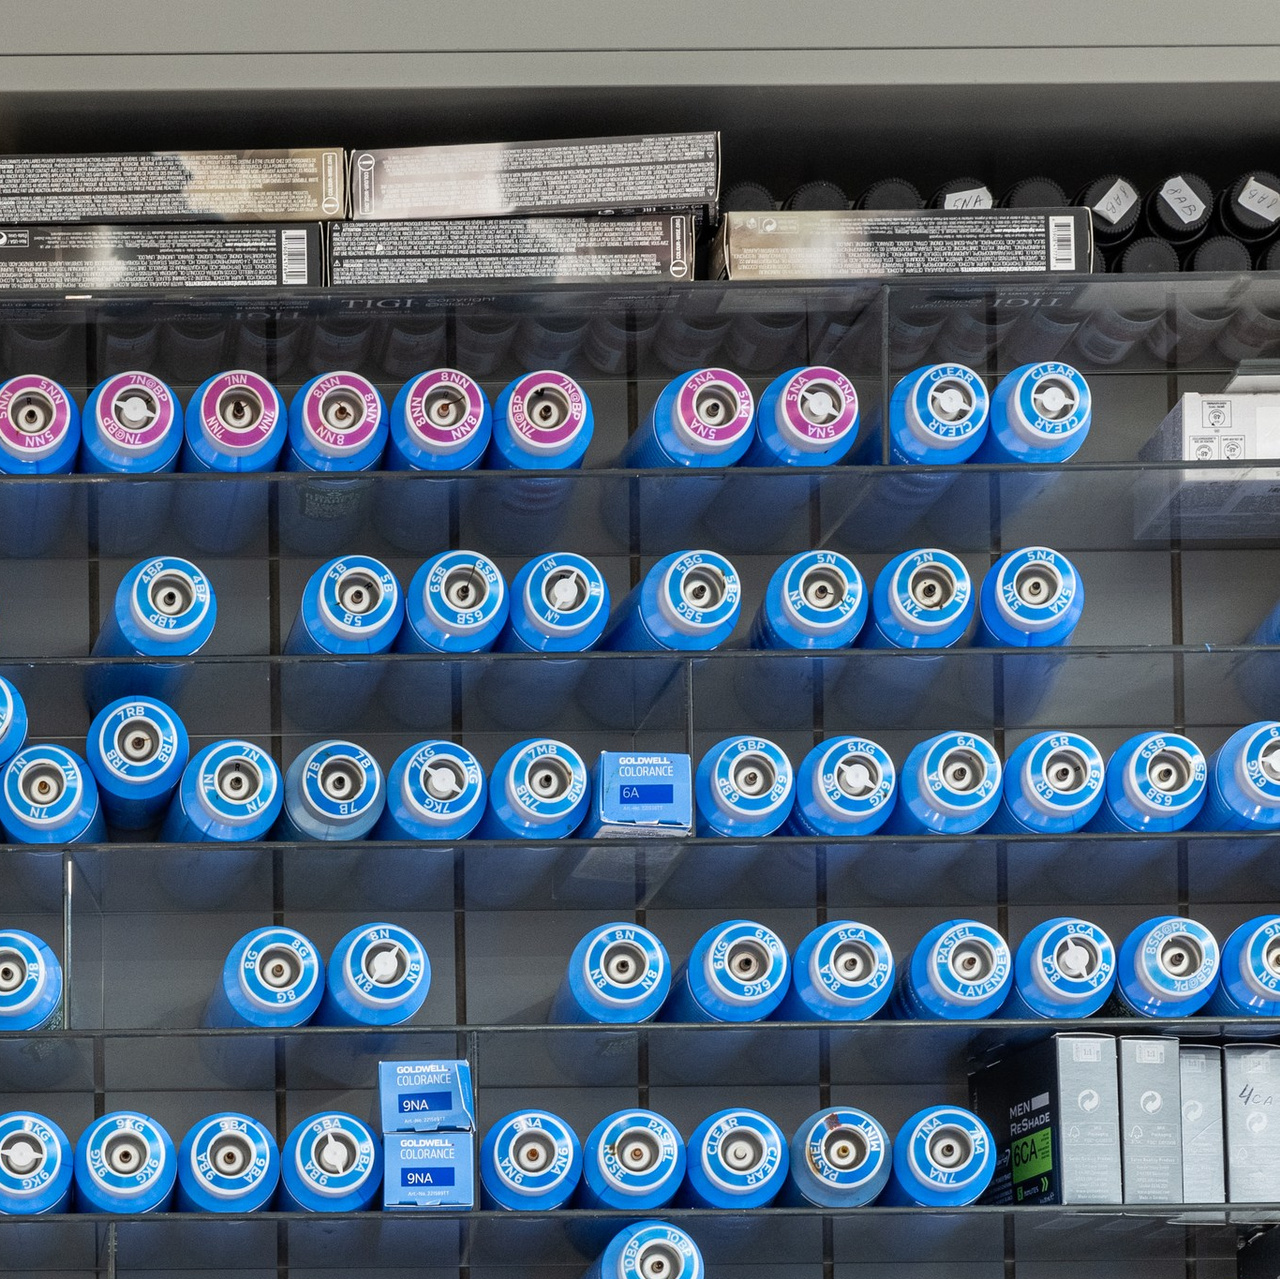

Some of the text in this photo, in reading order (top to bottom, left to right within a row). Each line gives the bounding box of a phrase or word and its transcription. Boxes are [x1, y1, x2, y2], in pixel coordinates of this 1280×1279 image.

[224, 374, 248, 386] 7NN
[440, 371, 470, 388] 8NN
[930, 368, 974, 383] CLEAR
[1031, 365, 1074, 380] CLEAR
[1027, 551, 1056, 563] 5NA
[847, 741, 876, 754] 6KG
[619, 766, 674, 776] COLORANCE
[623, 787, 639, 798] 6A
[839, 929, 866, 941] 8CA
[937, 927, 974, 965] PASTEL
[956, 947, 1008, 997] LAVENDER
[397, 1074, 451, 1086] COLORANCE
[403, 1100, 429, 1112] 9NA
[1010, 1101, 1030, 1119] MEN
[646, 1119, 675, 1163] PASTEL
[707, 1117, 739, 1156] CLEAR
[1013, 1140, 1038, 1166] 6CA
